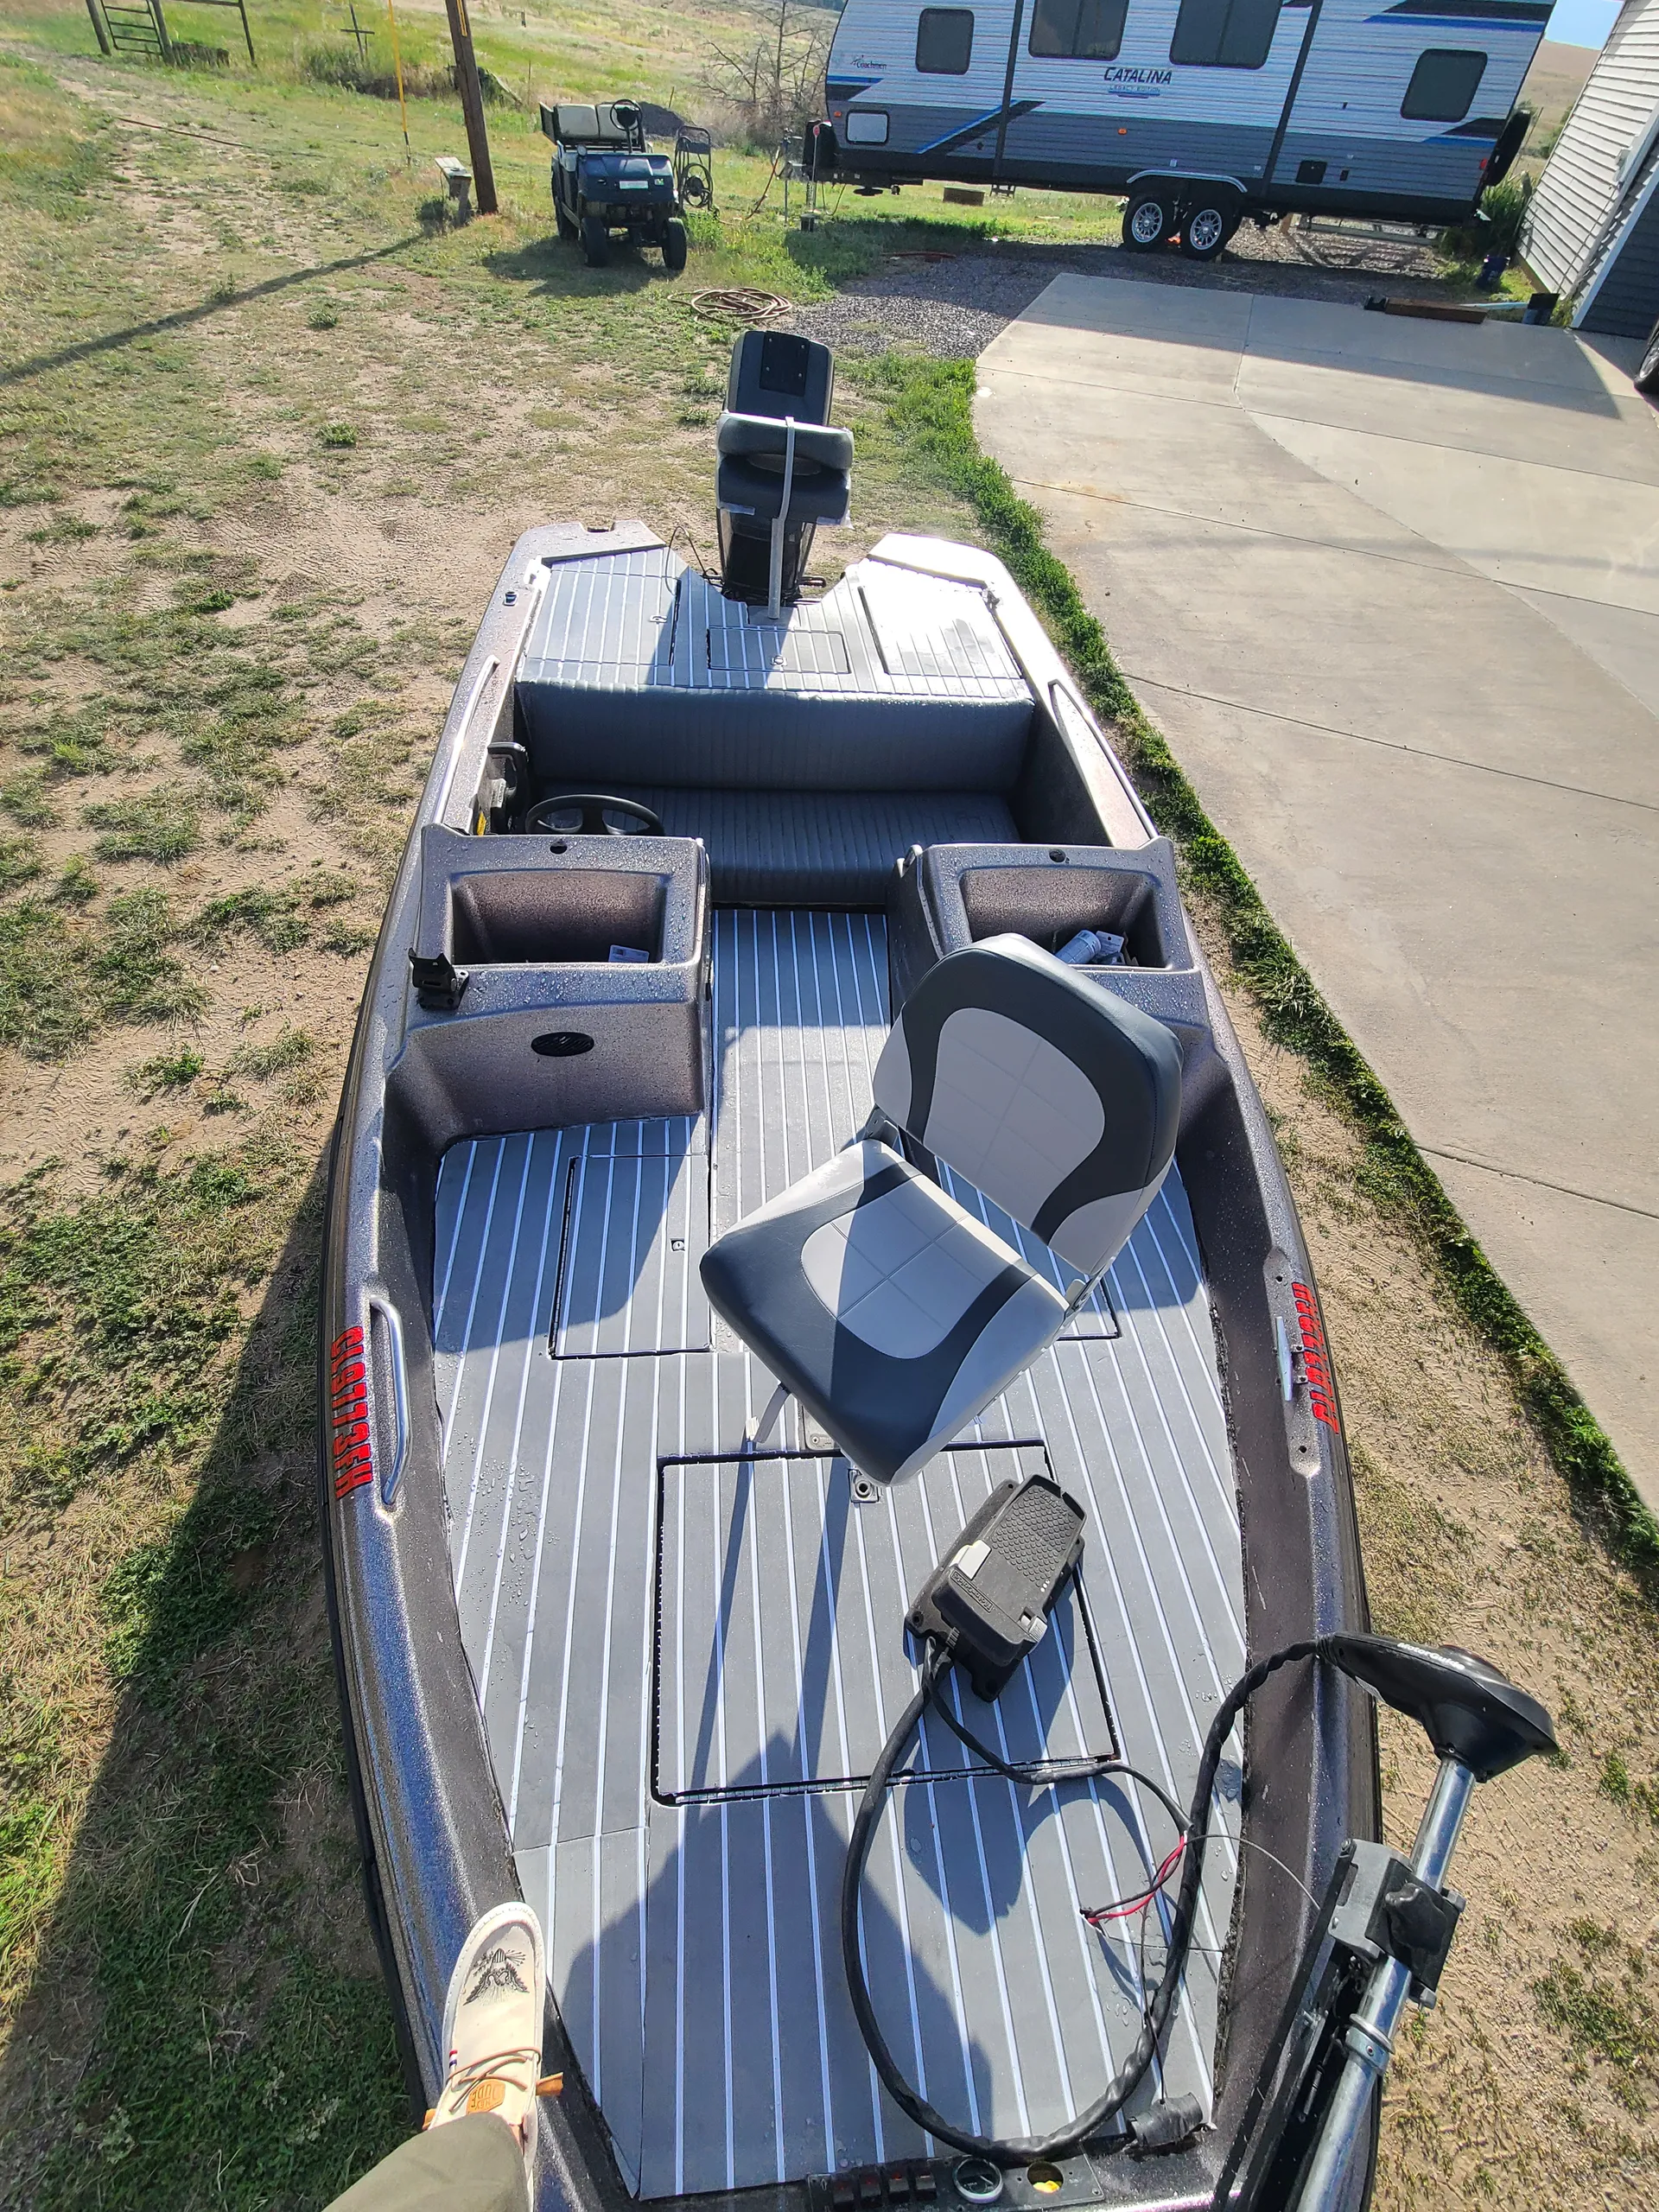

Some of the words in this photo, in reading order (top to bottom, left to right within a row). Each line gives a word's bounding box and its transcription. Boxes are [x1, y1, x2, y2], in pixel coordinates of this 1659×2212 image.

[856, 60, 887, 69] Coachmen
[1103, 67, 1173, 85] CATALINA
[330, 1325, 372, 1500] CL9773FH
[1397, 1641, 1466, 1670] MotorGuide
